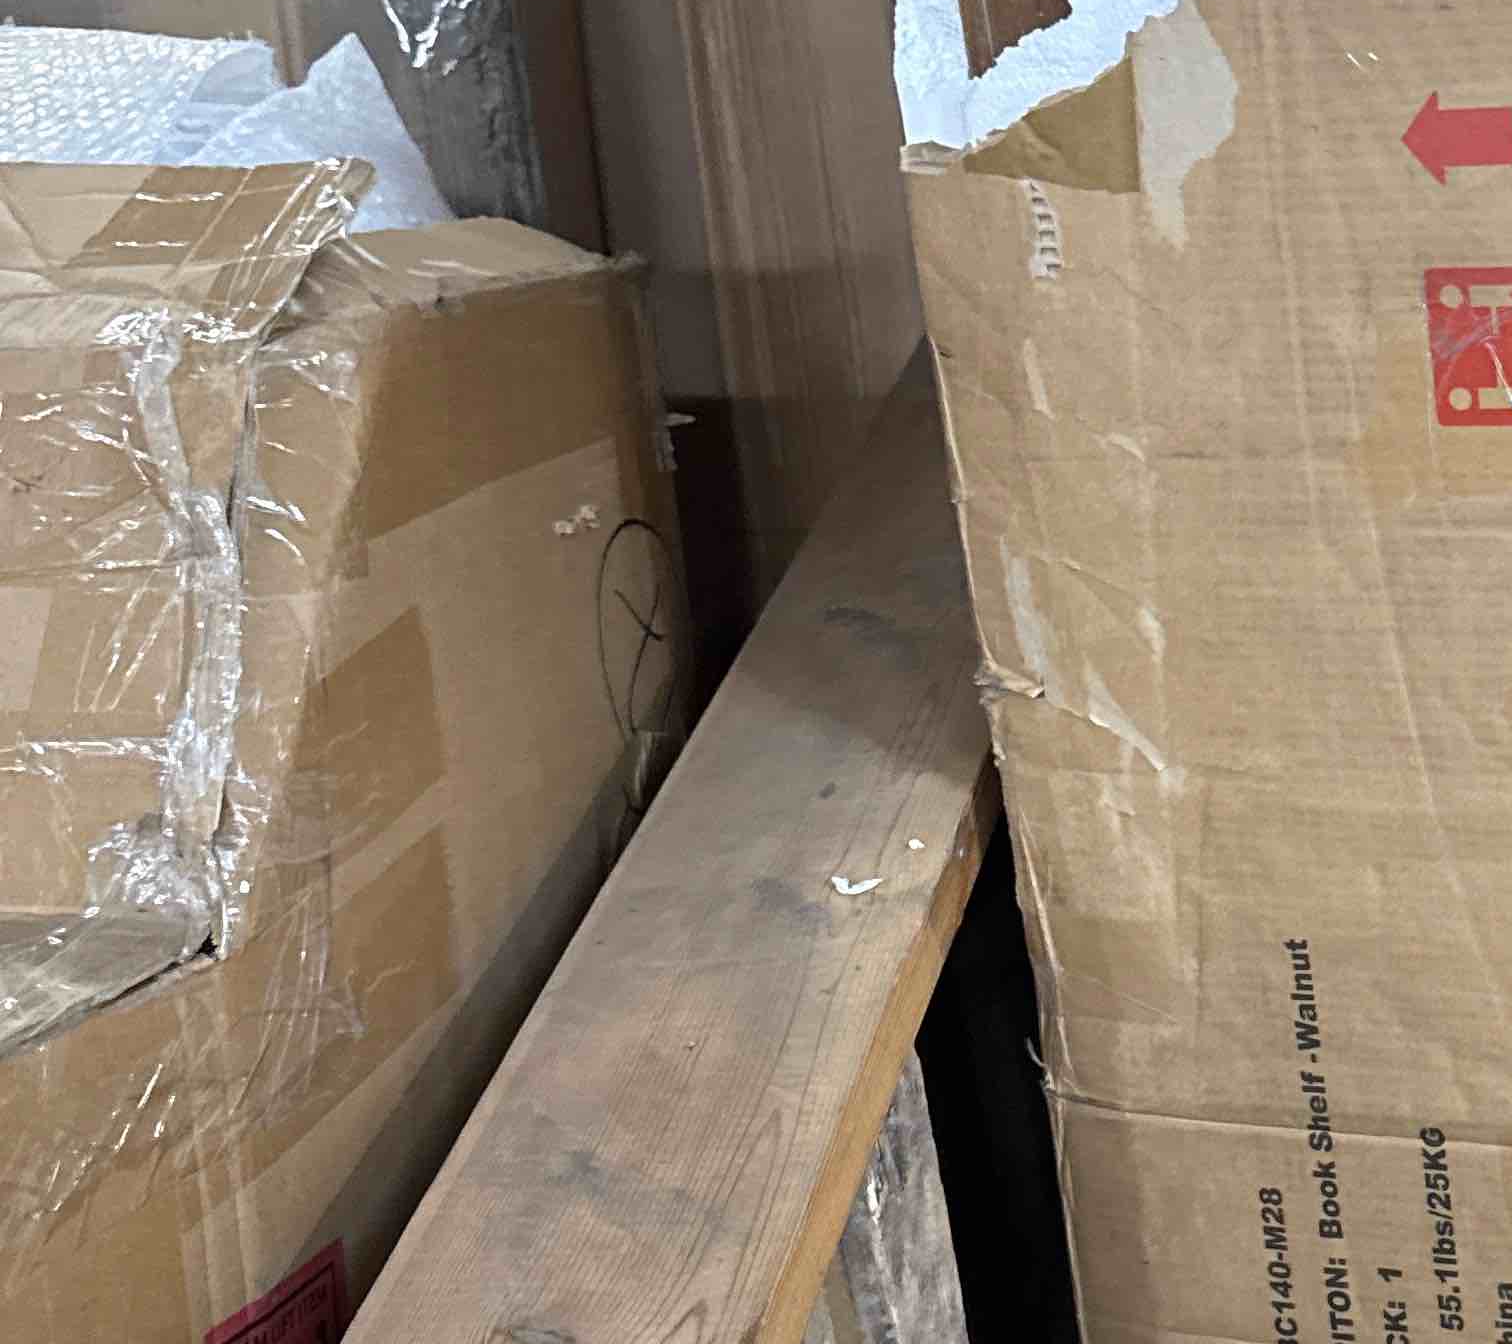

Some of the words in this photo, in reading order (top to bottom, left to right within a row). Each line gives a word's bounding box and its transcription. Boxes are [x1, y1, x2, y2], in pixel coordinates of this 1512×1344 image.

[1302, 1069, 1333, 1154] Shelf
[1311, 1158, 1344, 1240] Book
[1419, 1126, 1465, 1332] 55.1lbs/25KG
[1377, 1265, 1402, 1283] 1
